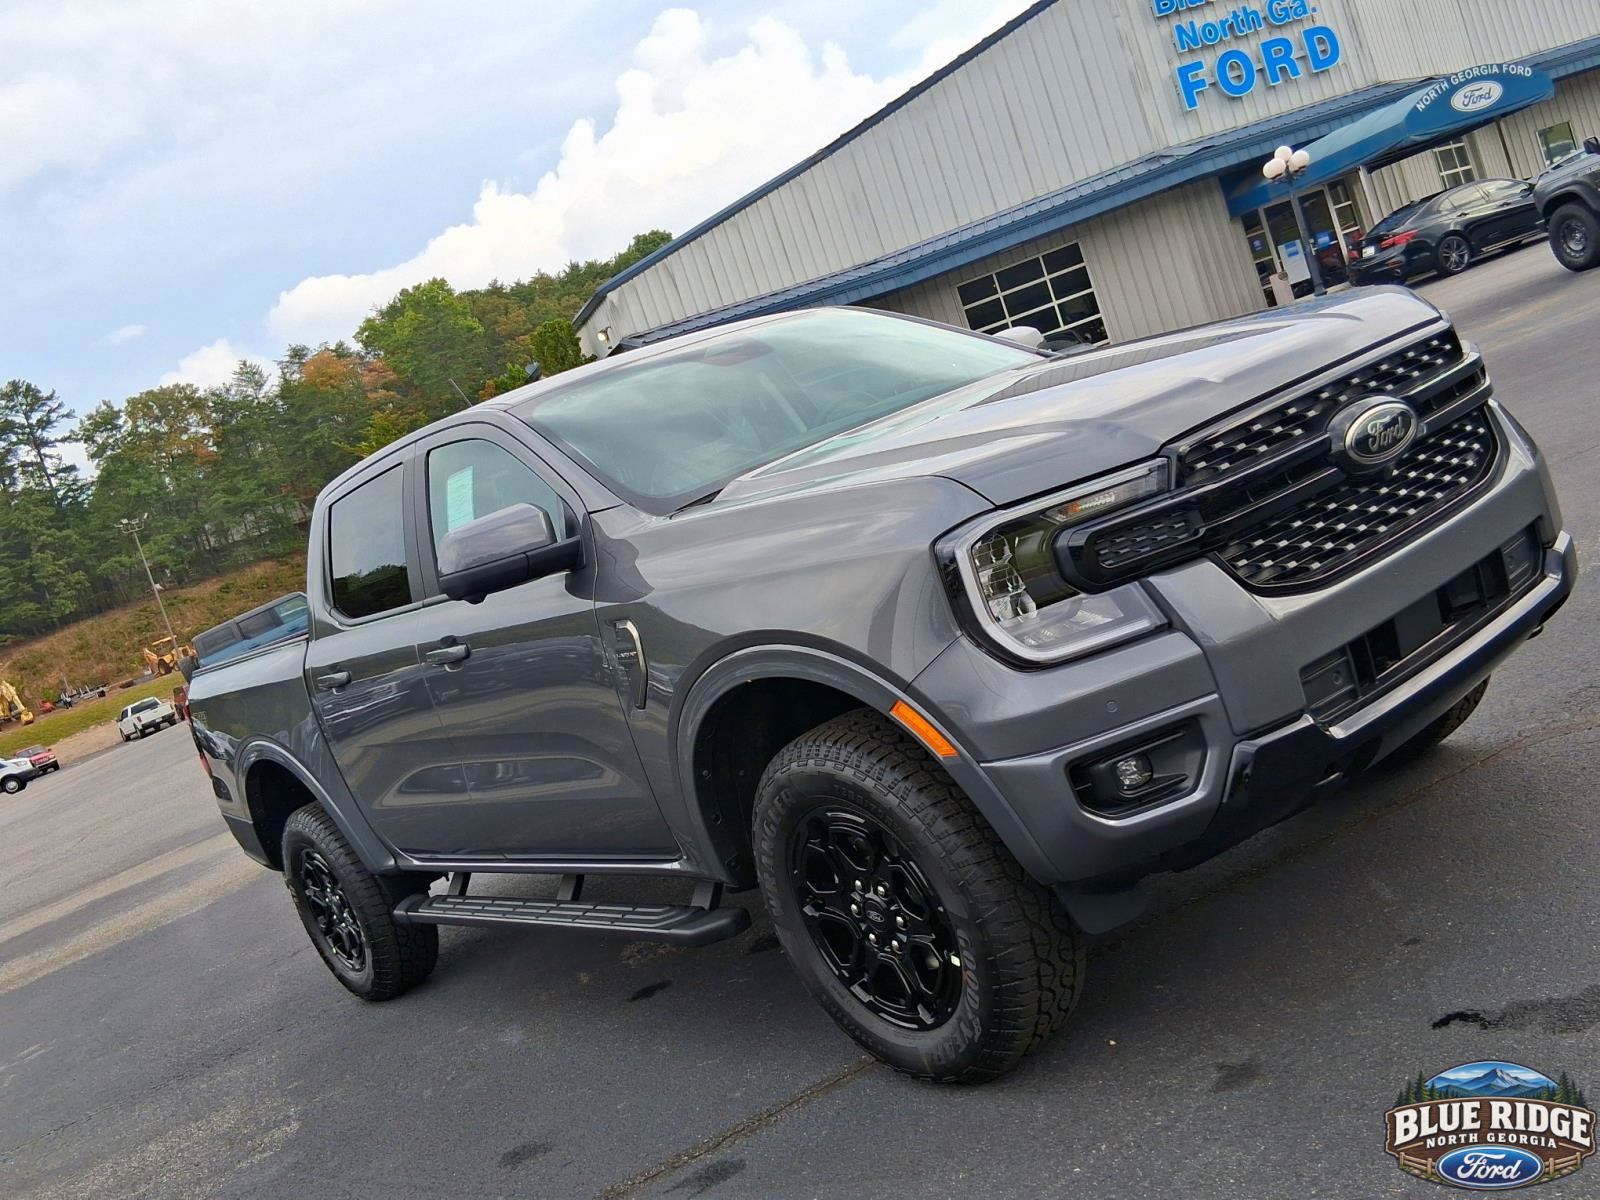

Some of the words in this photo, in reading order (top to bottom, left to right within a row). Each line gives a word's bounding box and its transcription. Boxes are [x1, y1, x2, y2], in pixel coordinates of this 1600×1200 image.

[1174, 6, 1264, 53] North
[1266, 0, 1319, 25] Ga.
[1176, 25, 1340, 110] FORD
[1415, 81, 1449, 112] NORTH
[1451, 64, 1499, 85] GEORGIA
[1502, 64, 1532, 77] FORD
[1462, 87, 1492, 107] Ford
[1367, 415, 1405, 451] Ford
